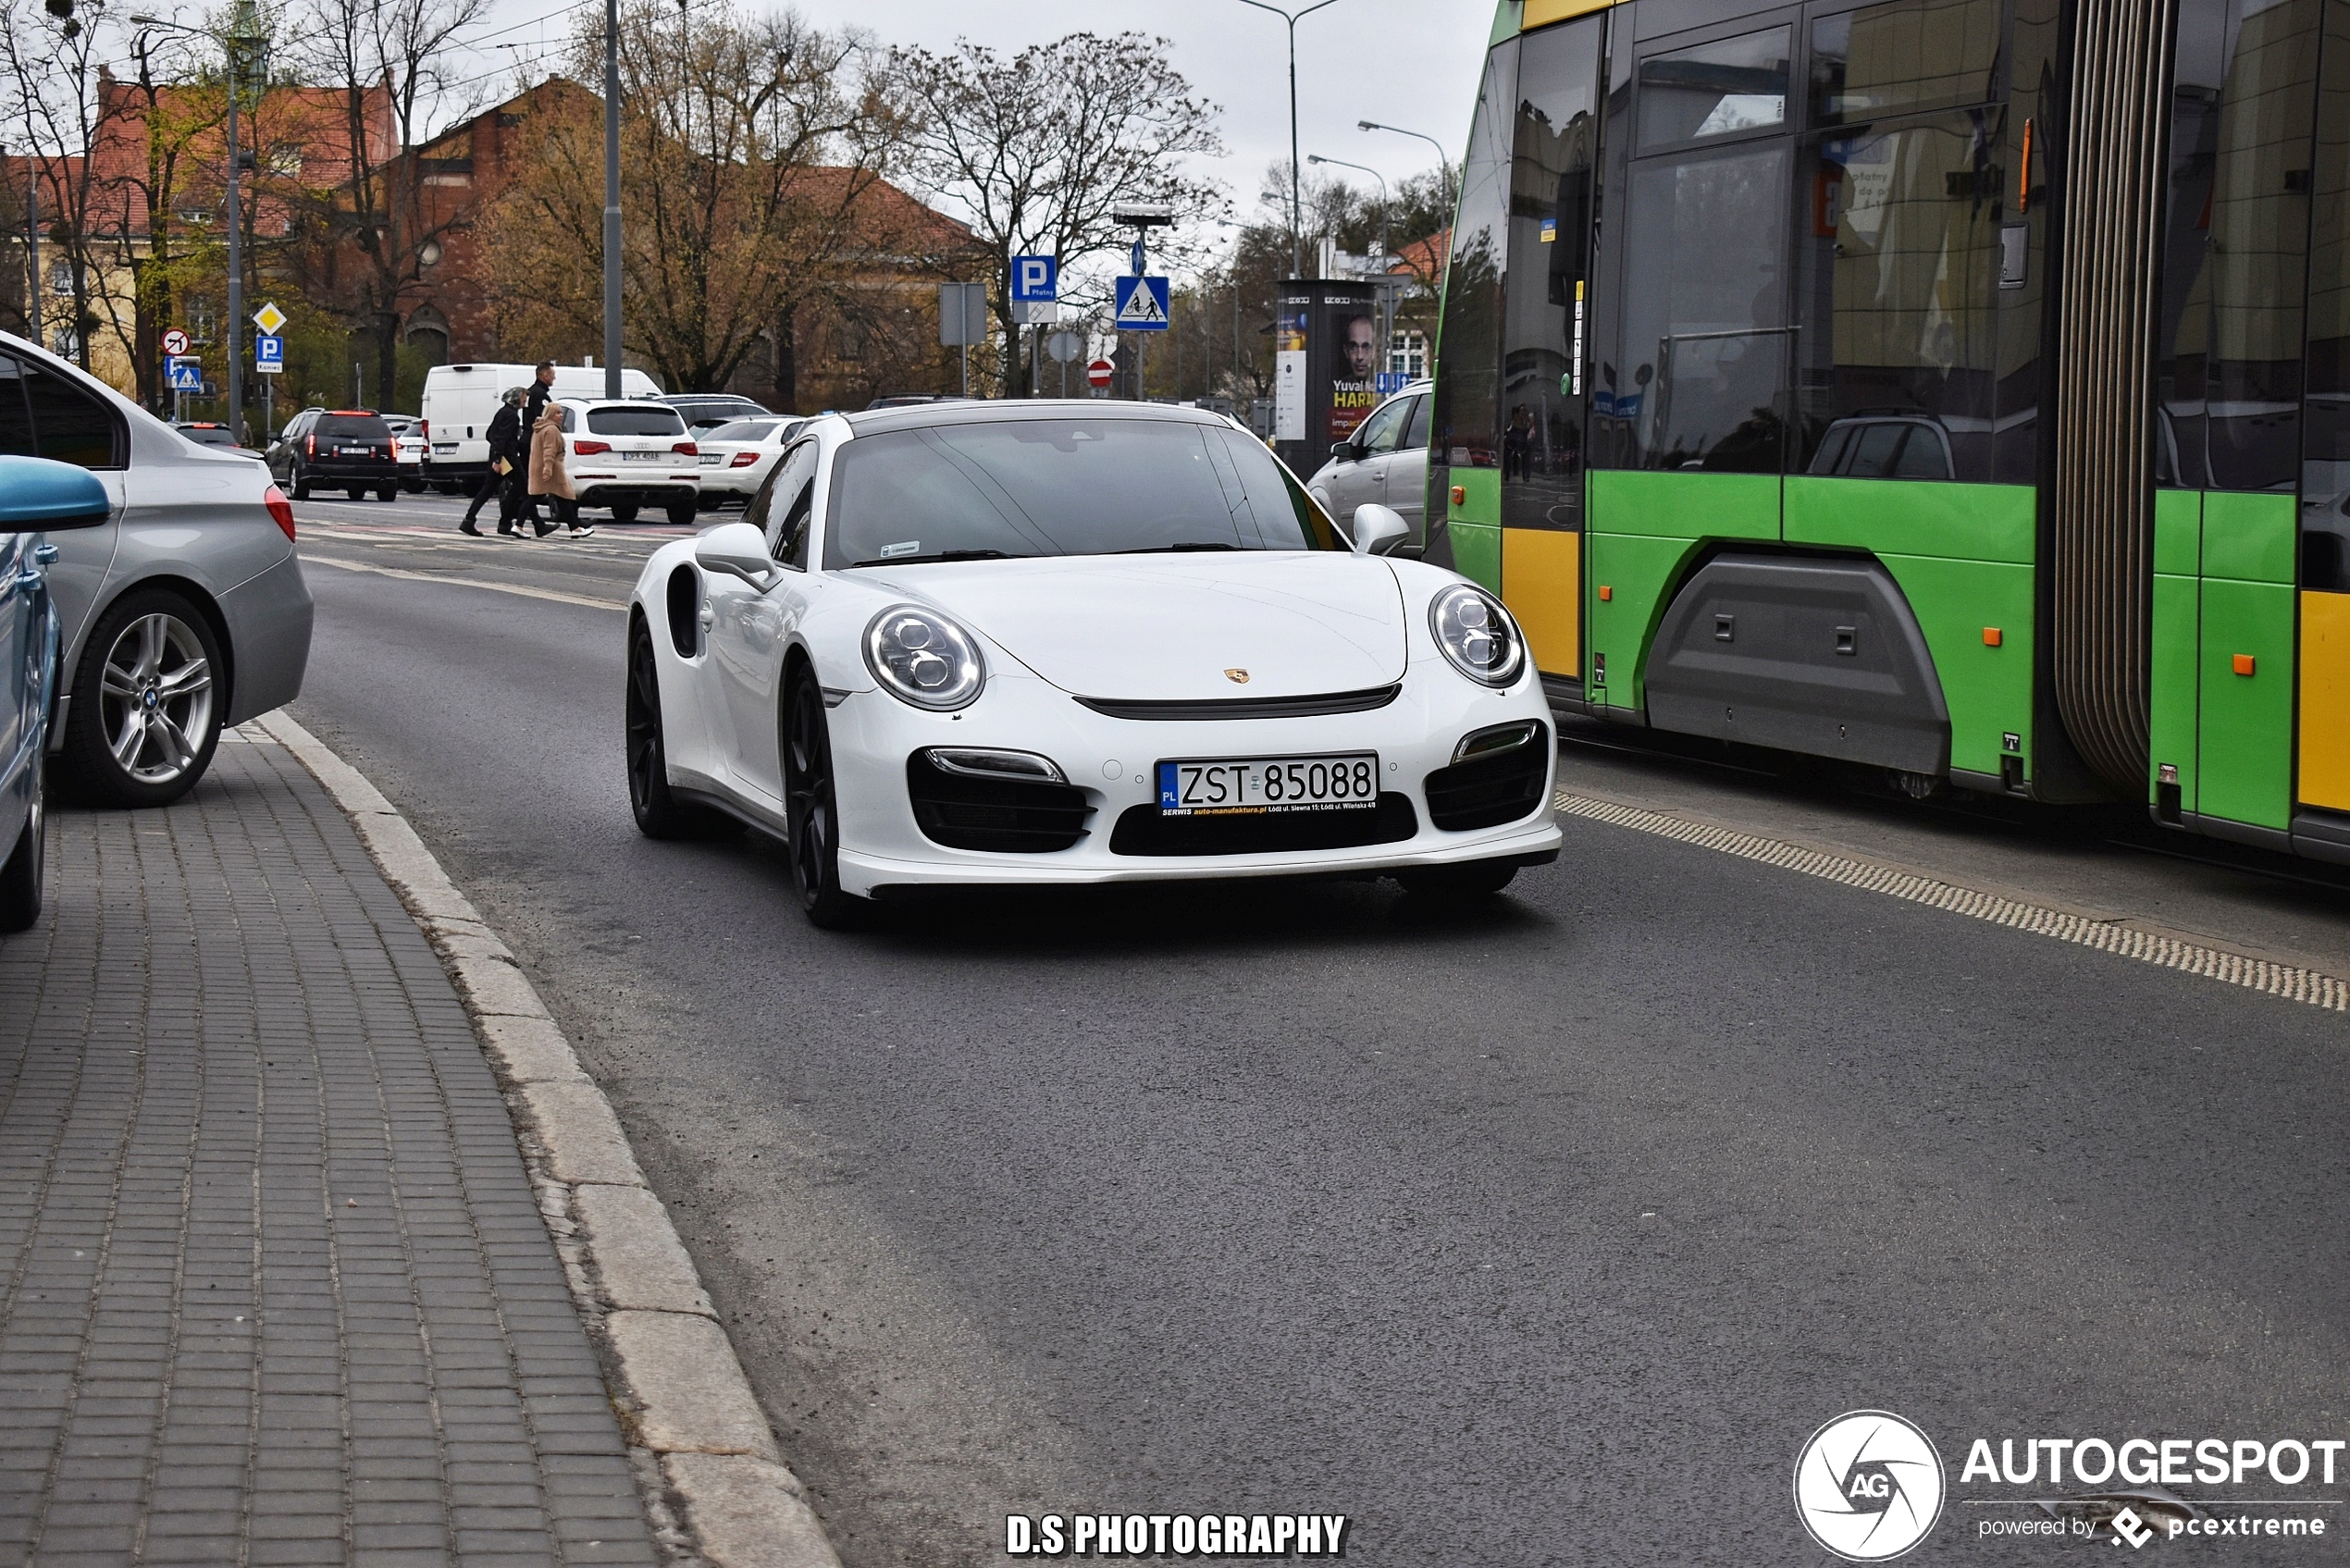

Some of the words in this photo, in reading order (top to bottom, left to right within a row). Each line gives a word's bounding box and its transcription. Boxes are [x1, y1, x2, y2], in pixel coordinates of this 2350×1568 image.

[1022, 260, 1047, 296] P
[1032, 289, 1054, 297] Płatny
[263, 339, 278, 359] P
[1333, 379, 1364, 391] Yuval
[1163, 792, 1176, 801] PL
[1181, 765, 1250, 804] ZST
[1265, 761, 1371, 801] 85088
[1194, 806, 1267, 815] auto-manufaktura.pl
